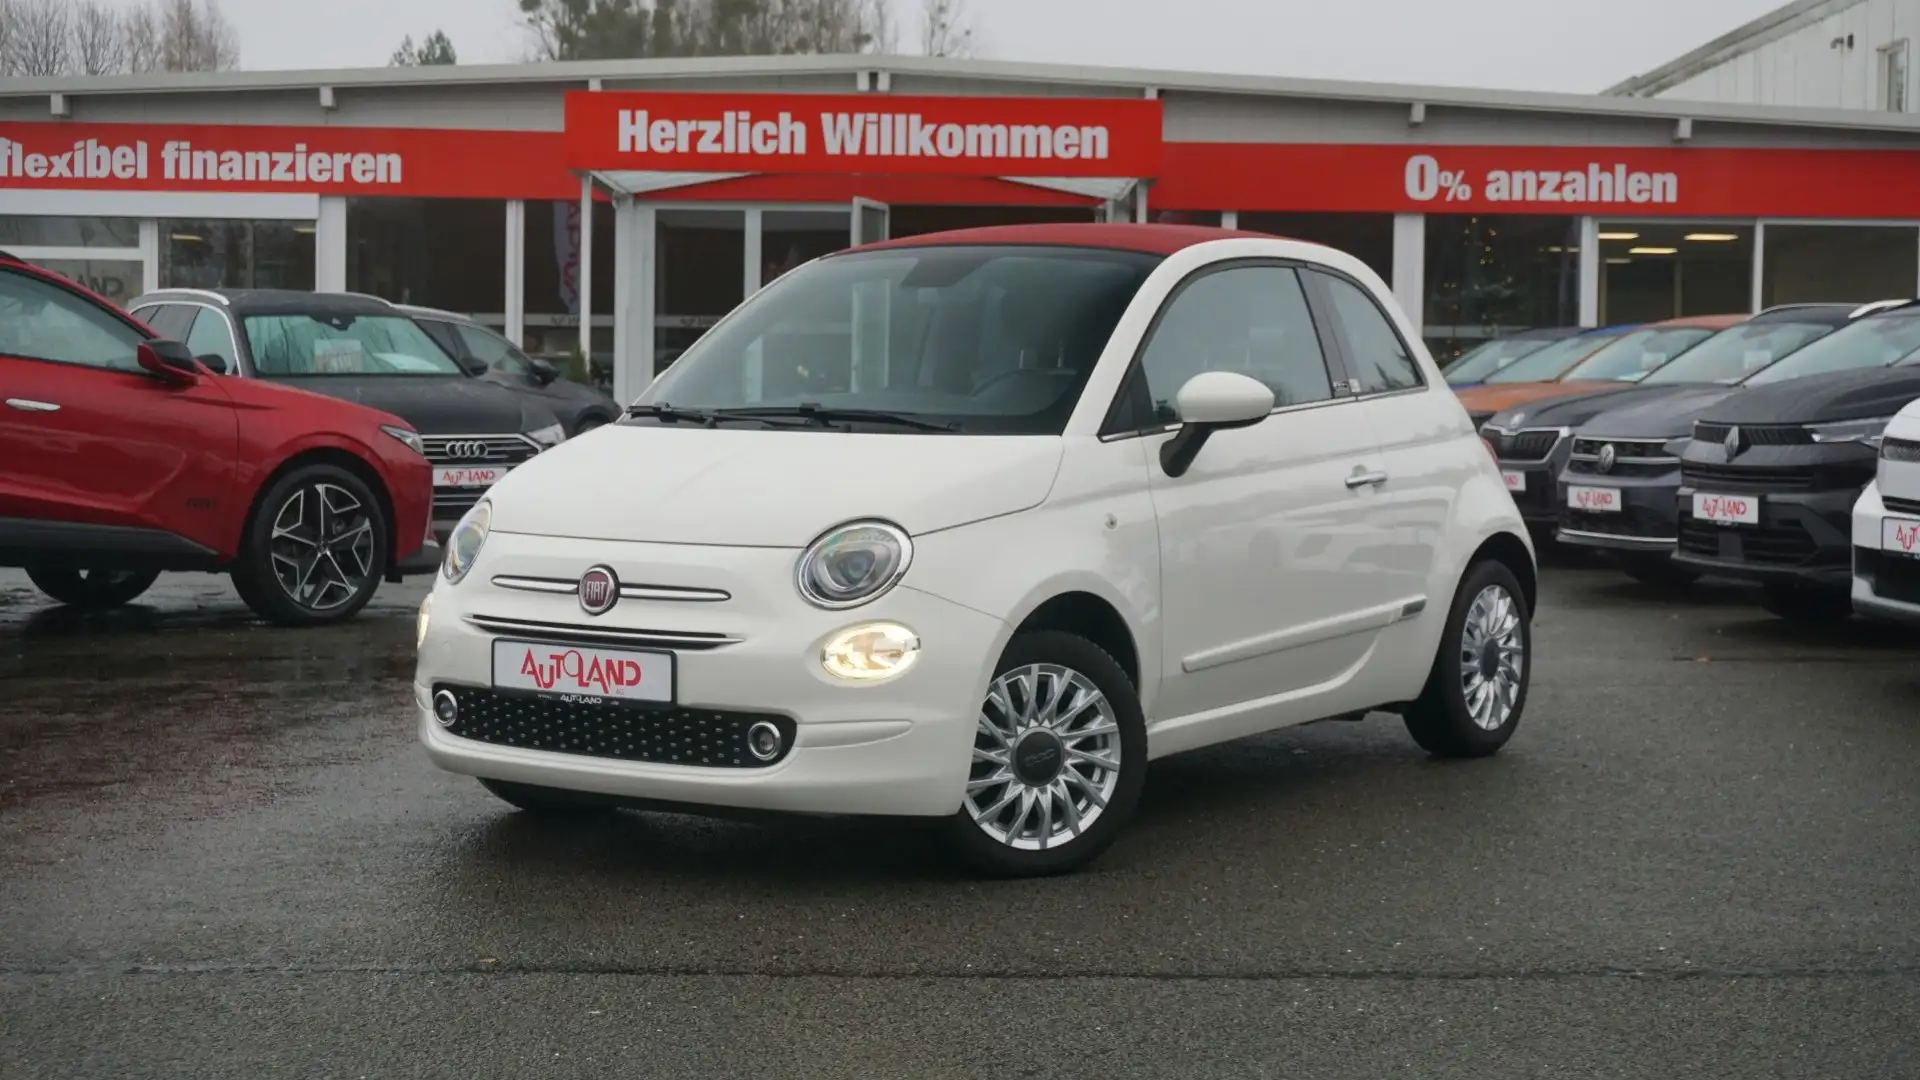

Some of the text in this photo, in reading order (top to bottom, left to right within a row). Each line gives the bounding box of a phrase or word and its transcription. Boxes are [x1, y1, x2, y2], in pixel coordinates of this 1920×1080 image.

[618, 109, 1109, 160] Herzlich Willkommen
[0, 136, 402, 184] flexibel finanzieren
[1404, 154, 1678, 204] 0% anzahlen
[586, 579, 607, 601] FIAT
[520, 647, 642, 695] AUTOLAND
